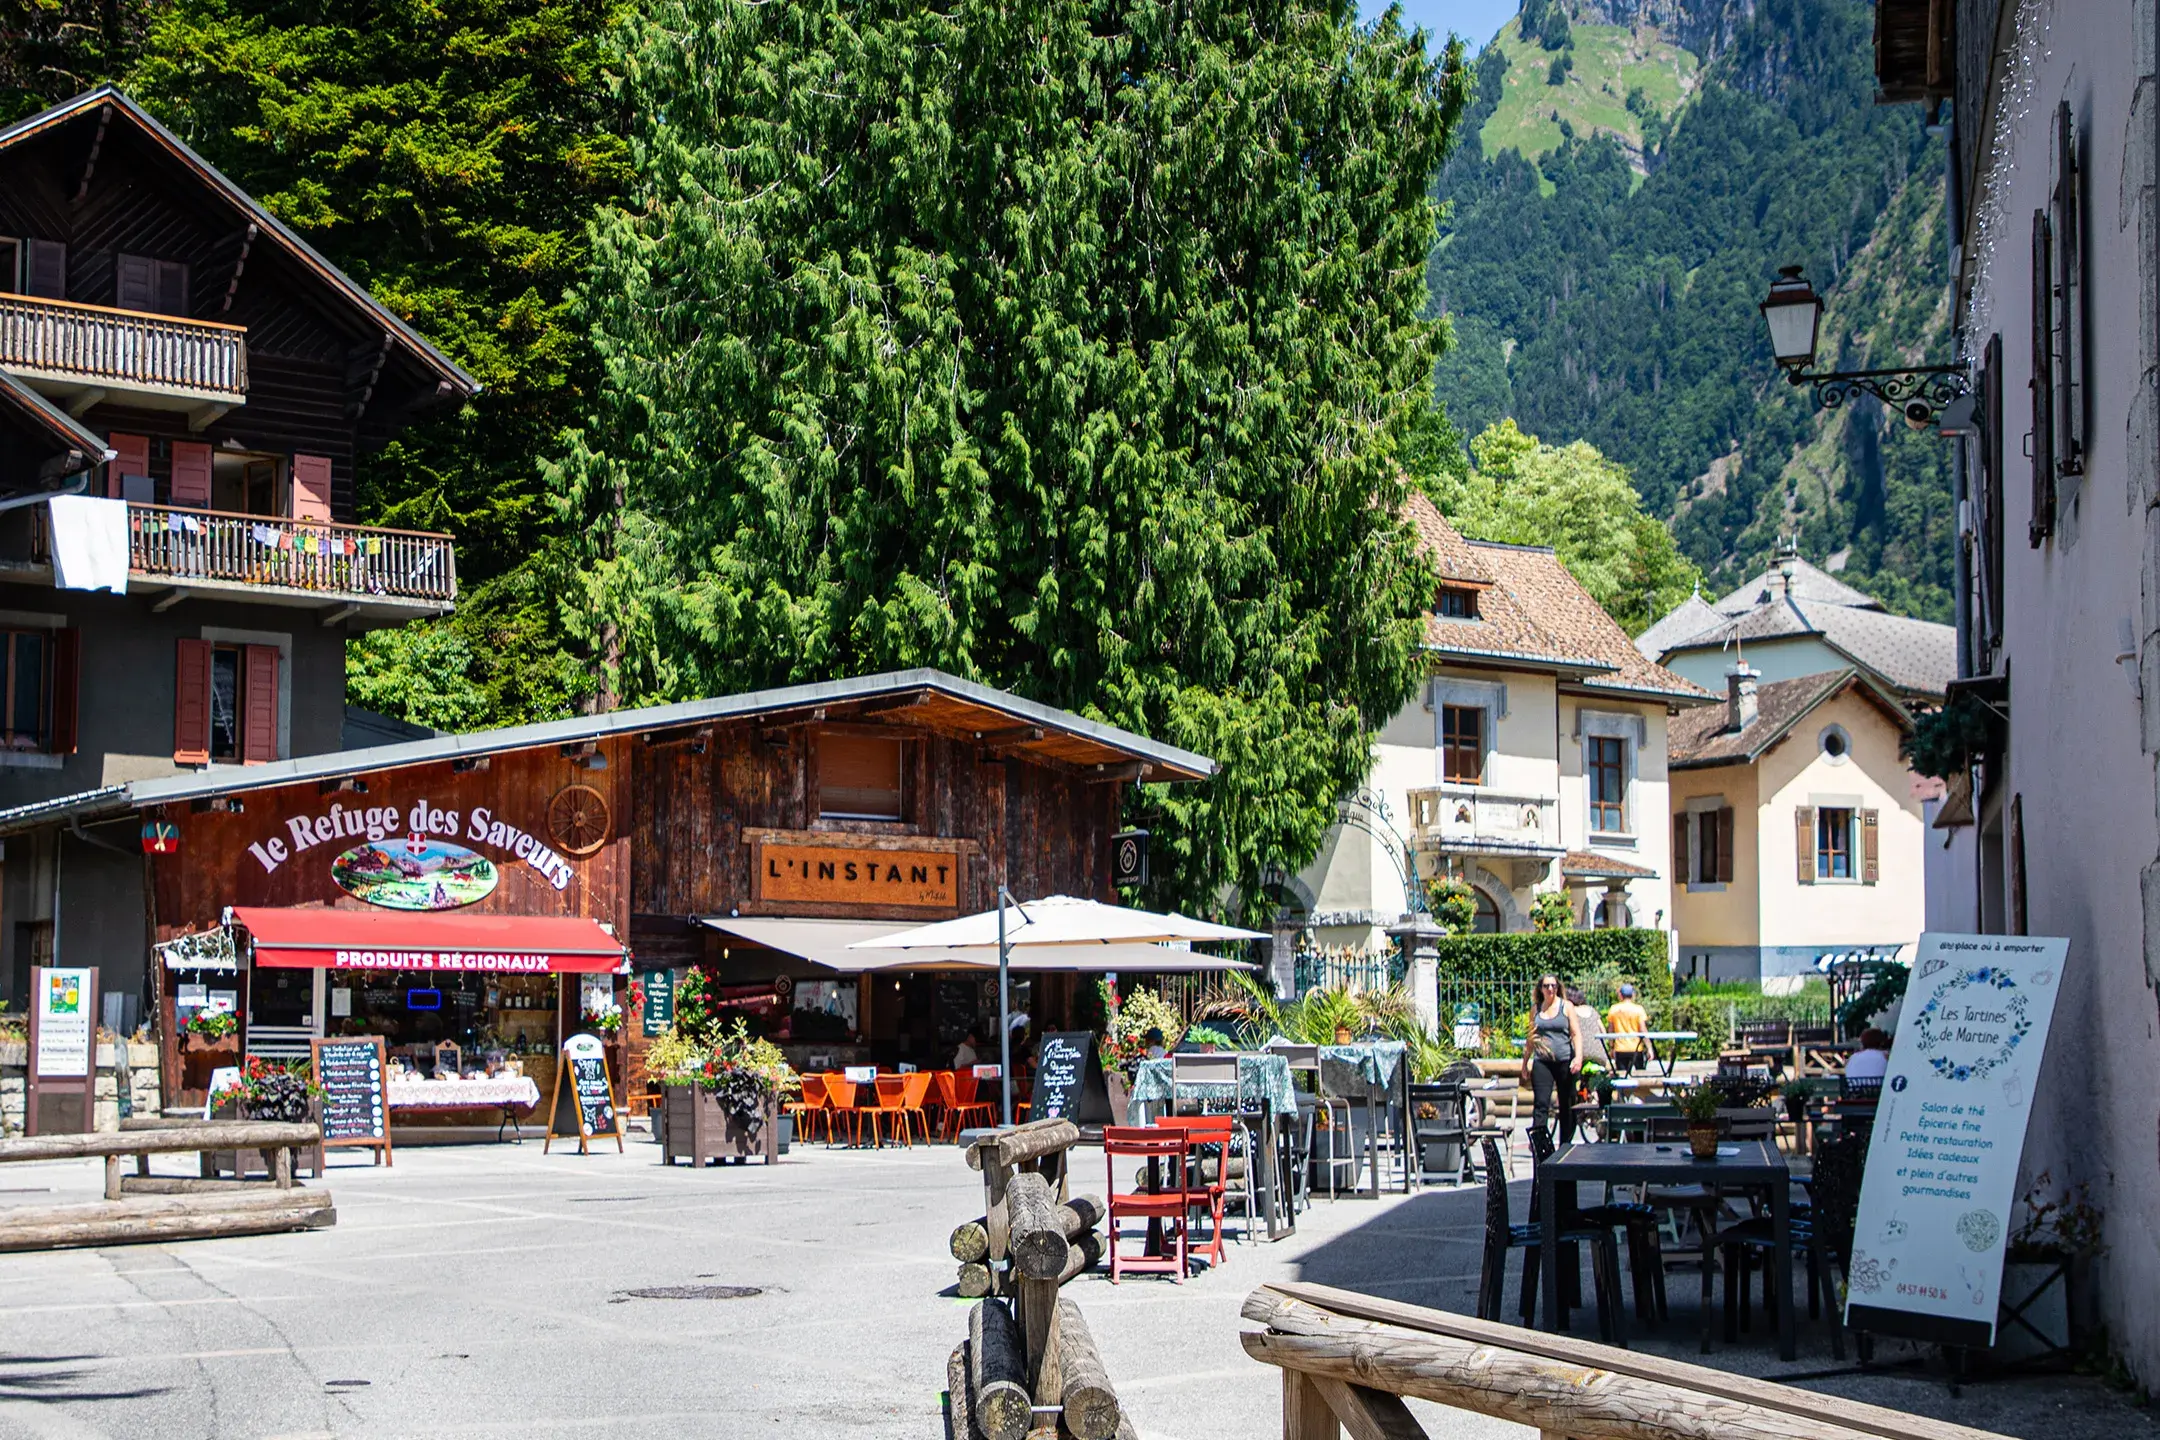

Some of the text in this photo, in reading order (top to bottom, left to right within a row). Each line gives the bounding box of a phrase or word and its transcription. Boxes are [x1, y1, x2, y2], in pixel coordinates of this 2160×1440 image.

[248, 800, 574, 891] le Refuge des Saveurs
[769, 859, 949, 884] L'INSTANT
[1995, 942, 2000, 951] à
[2004, 945, 2045, 954] emporter
[336, 951, 549, 970] PRODUITS RÉGIONAUX
[1941, 1006, 2007, 1023] Les Tartines
[1940, 1028, 1999, 1044] de Martine
[1922, 1102, 1985, 1116] Salon de thé
[1918, 1115, 1981, 1132] Épicerie fine
[1900, 1131, 1992, 1149] Petite restauration
[1907, 1148, 1980, 1164] Idées cadeaux
[1896, 1167, 1978, 1184] et plein d'autres
[1902, 1185, 1971, 1199] gourmandises
